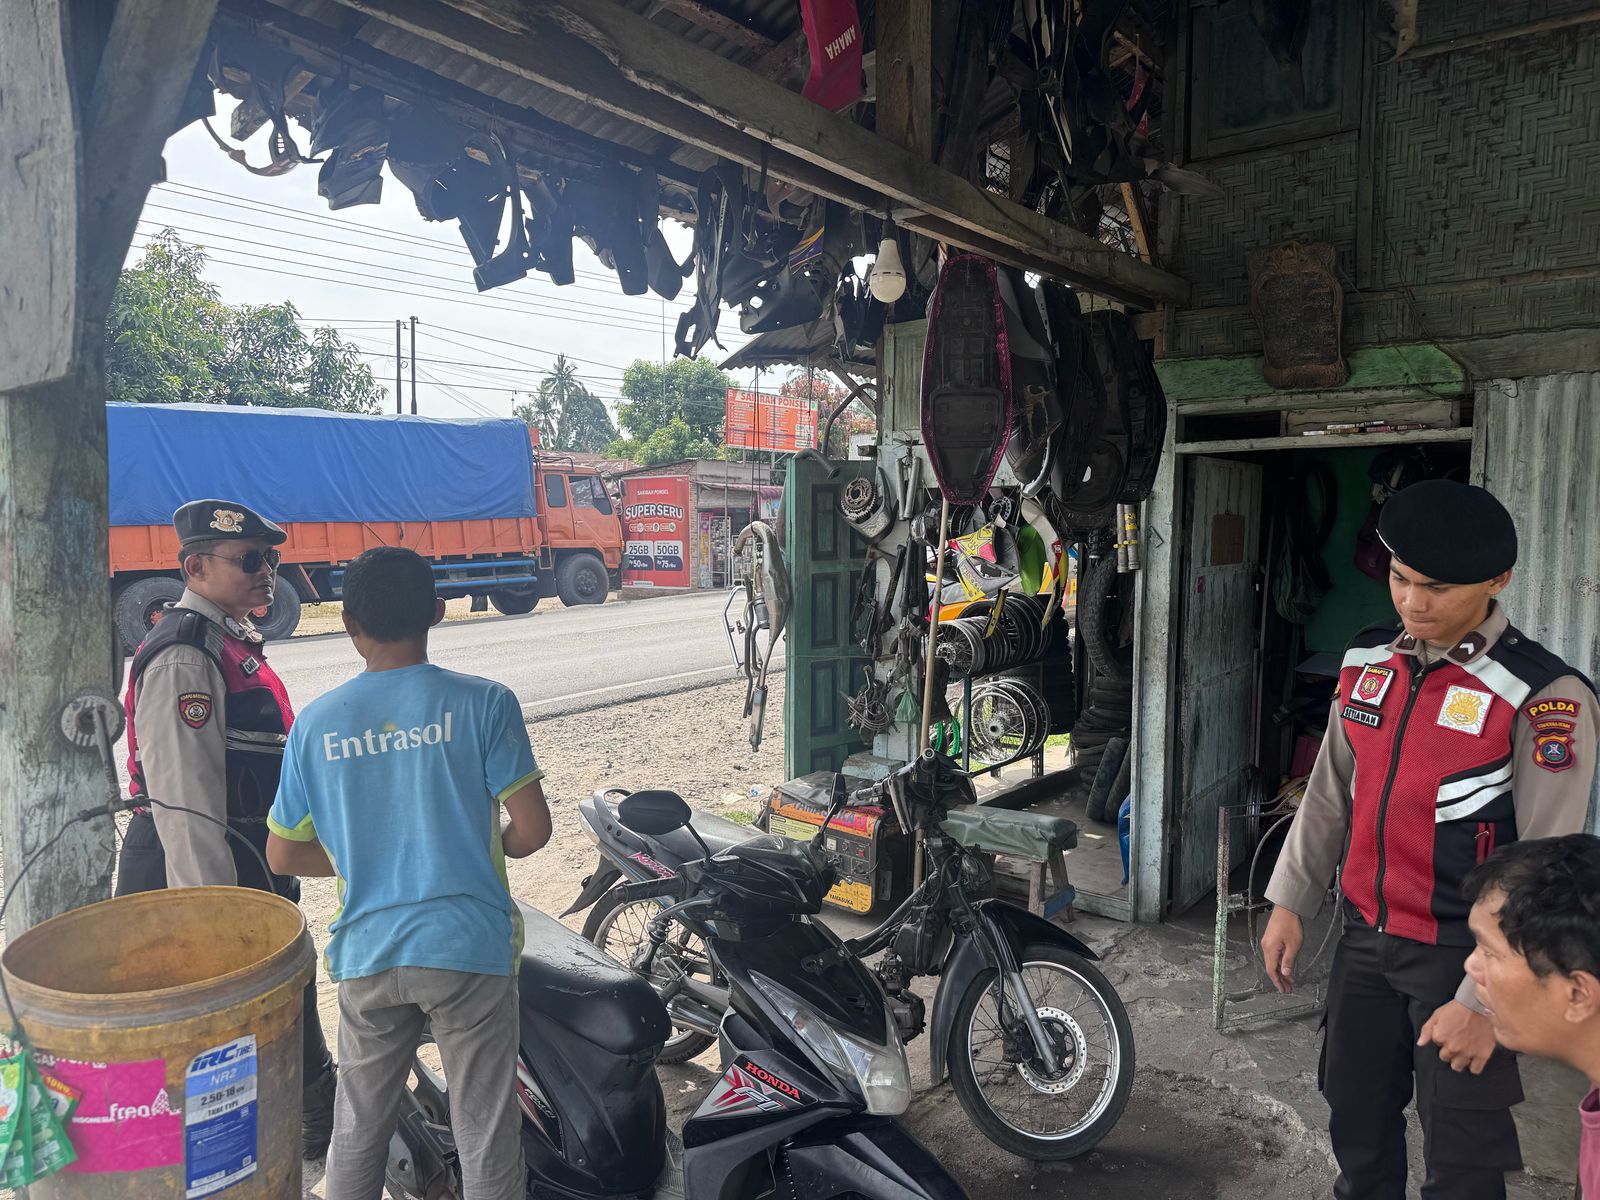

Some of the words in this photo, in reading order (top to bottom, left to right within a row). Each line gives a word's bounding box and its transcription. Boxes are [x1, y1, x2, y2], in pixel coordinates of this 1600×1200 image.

[779, 397, 808, 409] PONSEL
[629, 545, 649, 555] 25GB
[657, 545, 679, 555] 50GB
[1529, 701, 1575, 716] POLDA
[323, 711, 452, 761] Entrasol
[746, 1062, 801, 1100] HONDA
